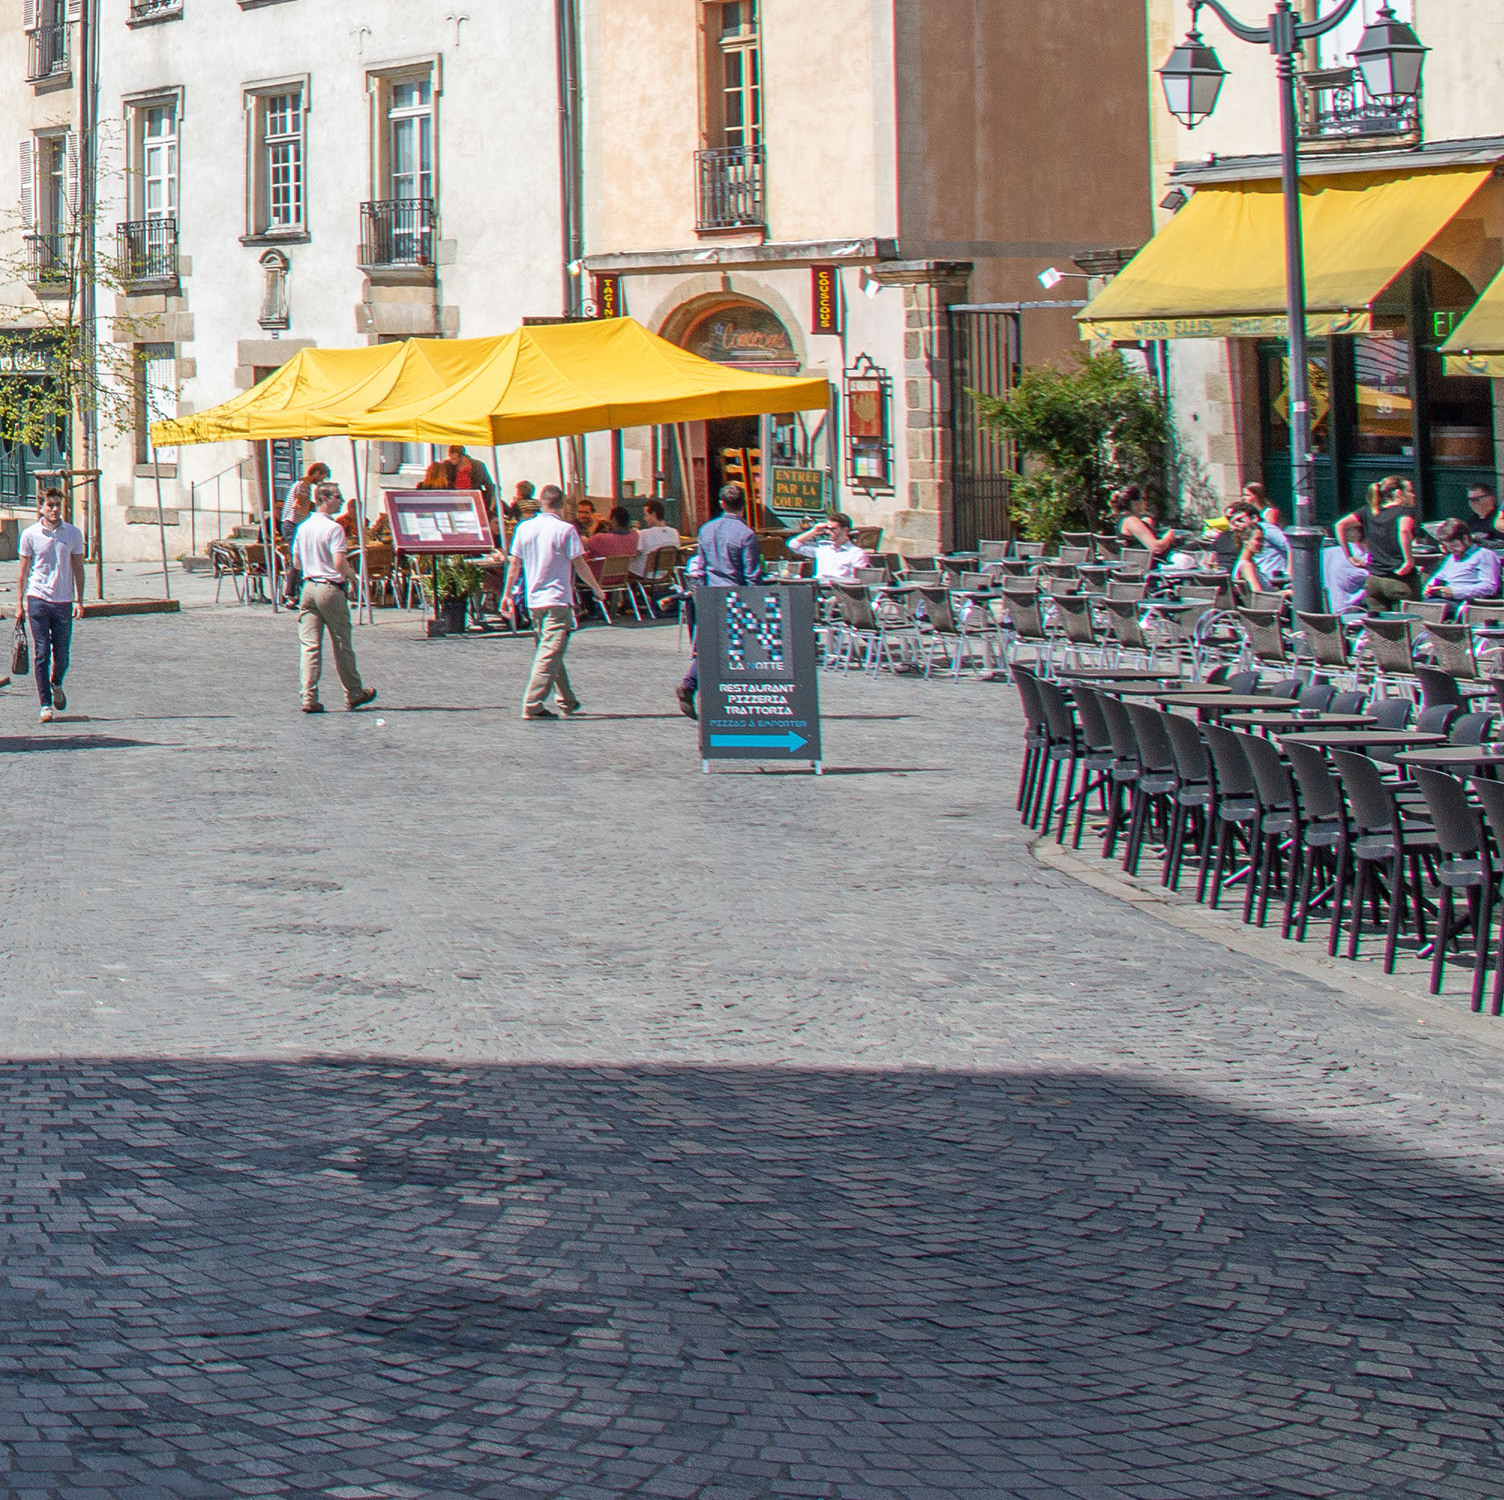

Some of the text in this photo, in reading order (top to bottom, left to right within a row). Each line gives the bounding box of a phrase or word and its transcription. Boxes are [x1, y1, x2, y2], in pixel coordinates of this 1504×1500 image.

[818, 271, 832, 328] COUSCOUS
[1132, 321, 1168, 337] WEBB
[1174, 319, 1212, 336] ELLIS
[777, 482, 817, 496] PAR LA
[773, 496, 803, 508] COUR
[728, 662, 785, 671] LA NOTTE
[719, 684, 795, 693] RESTAURANT
[728, 695, 788, 704] PIZZERIA
[724, 706, 793, 715] TRATTORIA
